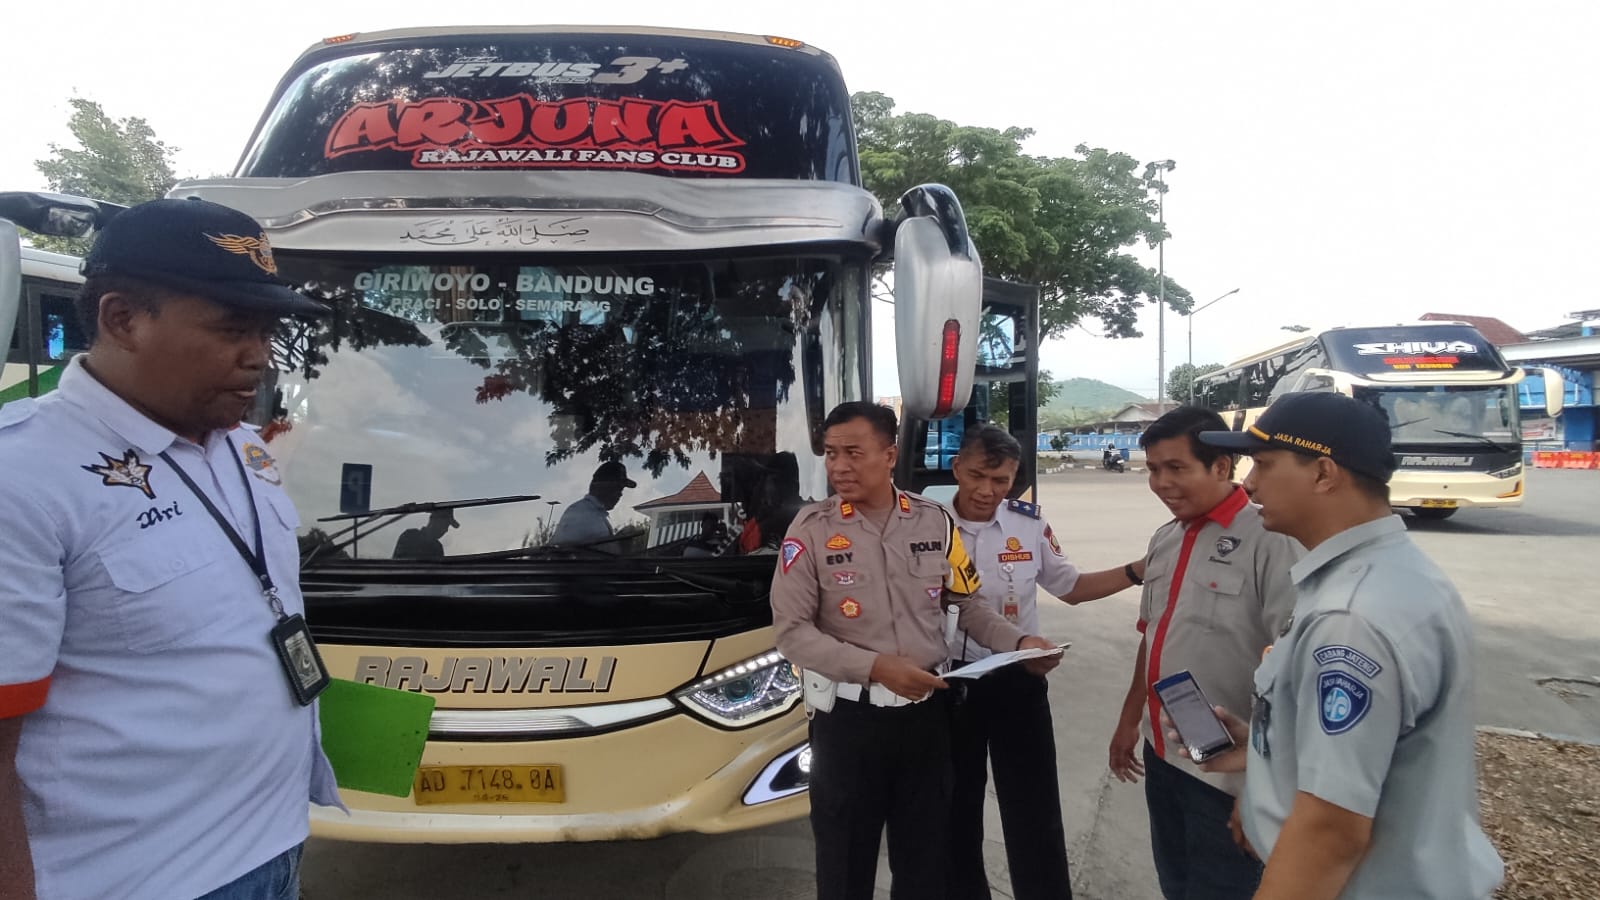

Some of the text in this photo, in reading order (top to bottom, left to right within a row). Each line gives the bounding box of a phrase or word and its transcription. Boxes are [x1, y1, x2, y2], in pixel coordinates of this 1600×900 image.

[424, 56, 689, 84] JETBUS 3+
[326, 95, 740, 156] ARJUNA
[419, 149, 738, 168] RAJAWALI FANS CLUB
[353, 272, 490, 292] GIRIWOYO
[515, 274, 655, 295] BANDUNG
[390, 298, 440, 310] PRACI
[455, 298, 500, 311] SOLO
[515, 299, 611, 313] SEMARANG
[1353, 341, 1478, 355] SHIVA
[1274, 433, 1331, 455] JASA RAHARJA
[910, 541, 942, 553] POLRI
[826, 552, 853, 565] EDY
[1346, 652, 1375, 673] JATENG
[354, 655, 617, 693] RAJAWALI
[421, 770, 445, 792] AD
